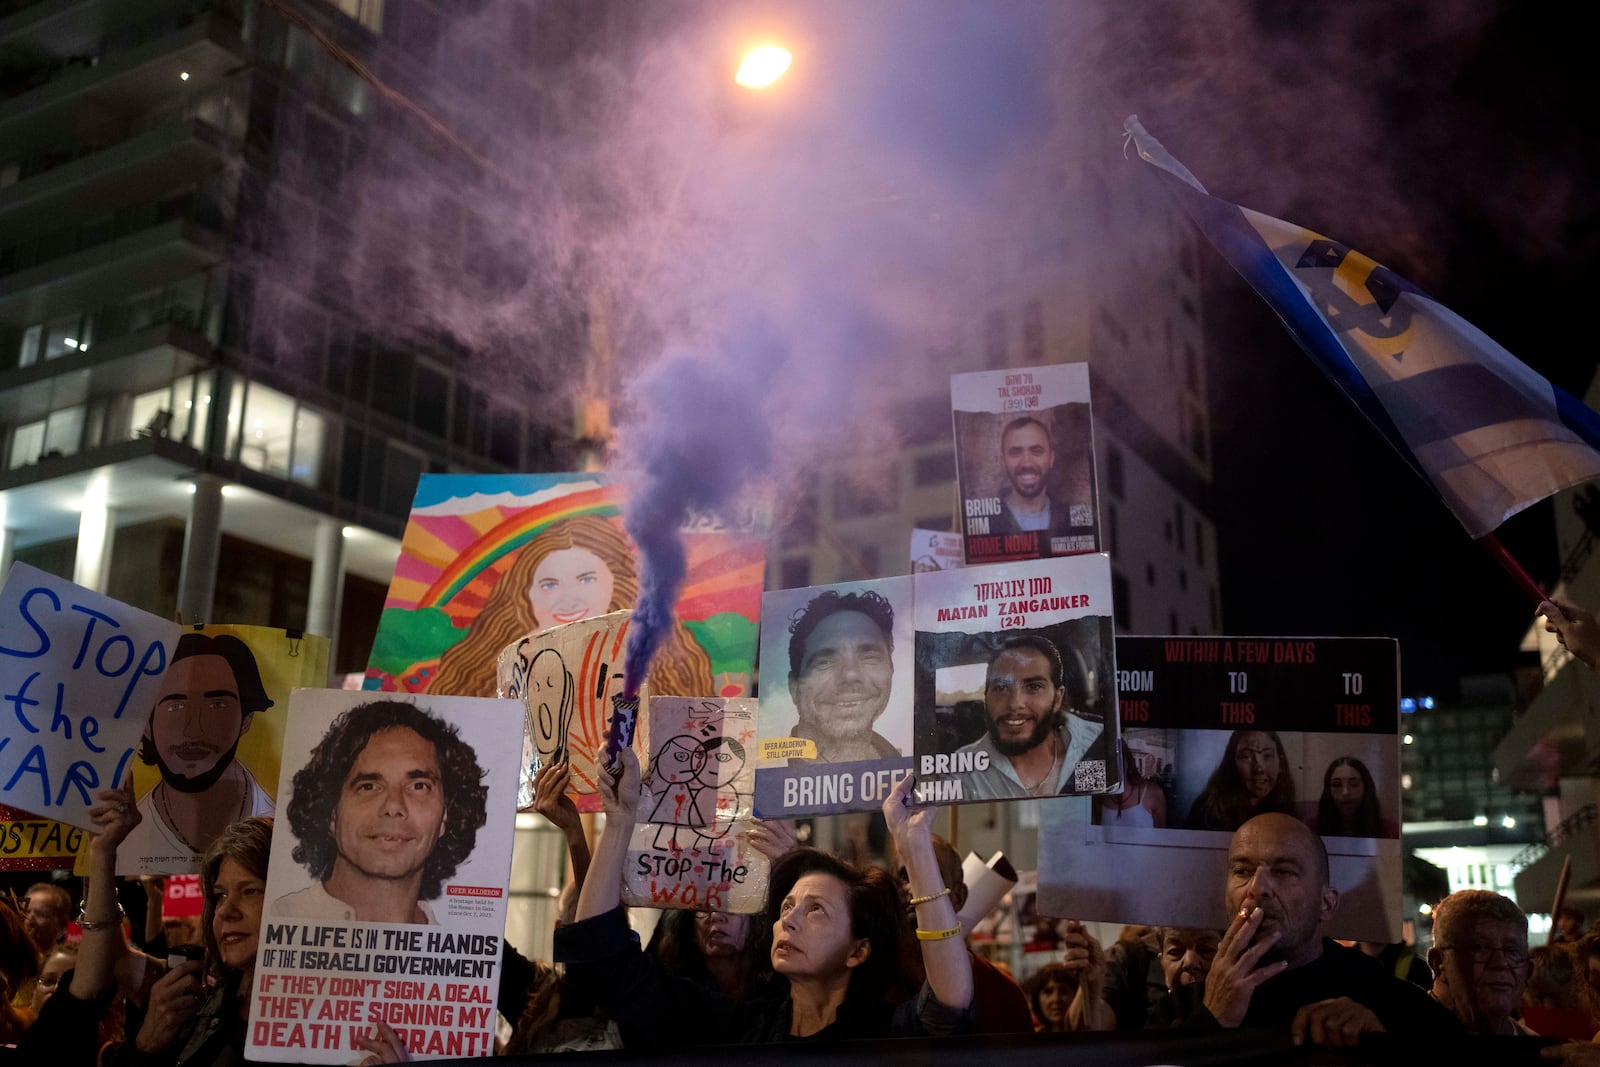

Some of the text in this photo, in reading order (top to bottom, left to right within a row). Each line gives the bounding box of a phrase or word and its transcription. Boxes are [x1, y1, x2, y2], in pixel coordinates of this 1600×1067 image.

[998, 384, 1042, 398] TAL SHOHAM
[1003, 398, 1023, 410] (39)
[966, 498, 1000, 516] BRING
[968, 518, 990, 535] HIM
[968, 536, 1000, 554] HOME
[1004, 532, 1038, 552] NOW!
[1029, 576, 1052, 597] מתן
[937, 594, 1090, 622] MATAN ZANGAUKER
[1000, 616, 1026, 628] (24)
[0, 587, 166, 719] STOP
[1164, 642, 1316, 663] WITHIN A FEW DAYS
[1228, 672, 1247, 694] TO
[1342, 672, 1362, 695] TO
[4, 672, 106, 753] the
[1220, 702, 1254, 724] THIS
[1336, 704, 1372, 726] THIS
[764, 740, 806, 750] OFER KALDERON
[767, 749, 804, 759] STILL CAPTIVE
[0, 737, 134, 806] AR!
[920, 750, 990, 775] BRING
[784, 773, 854, 808] BRING
[920, 780, 963, 802] HIM
[638, 854, 748, 884] STOP The
[468, 888, 500, 896] KALDERON
[265, 924, 498, 956] MY LIFE IS IN THE HANDS
[262, 949, 496, 978] OF THE ISRAELI GOVERNMENT
[260, 974, 492, 1004] IF THEY DON'T SIGN A DEAL
[258, 996, 492, 1029] THEY ARE SIGNING MY
[252, 1021, 341, 1050] DEATH
